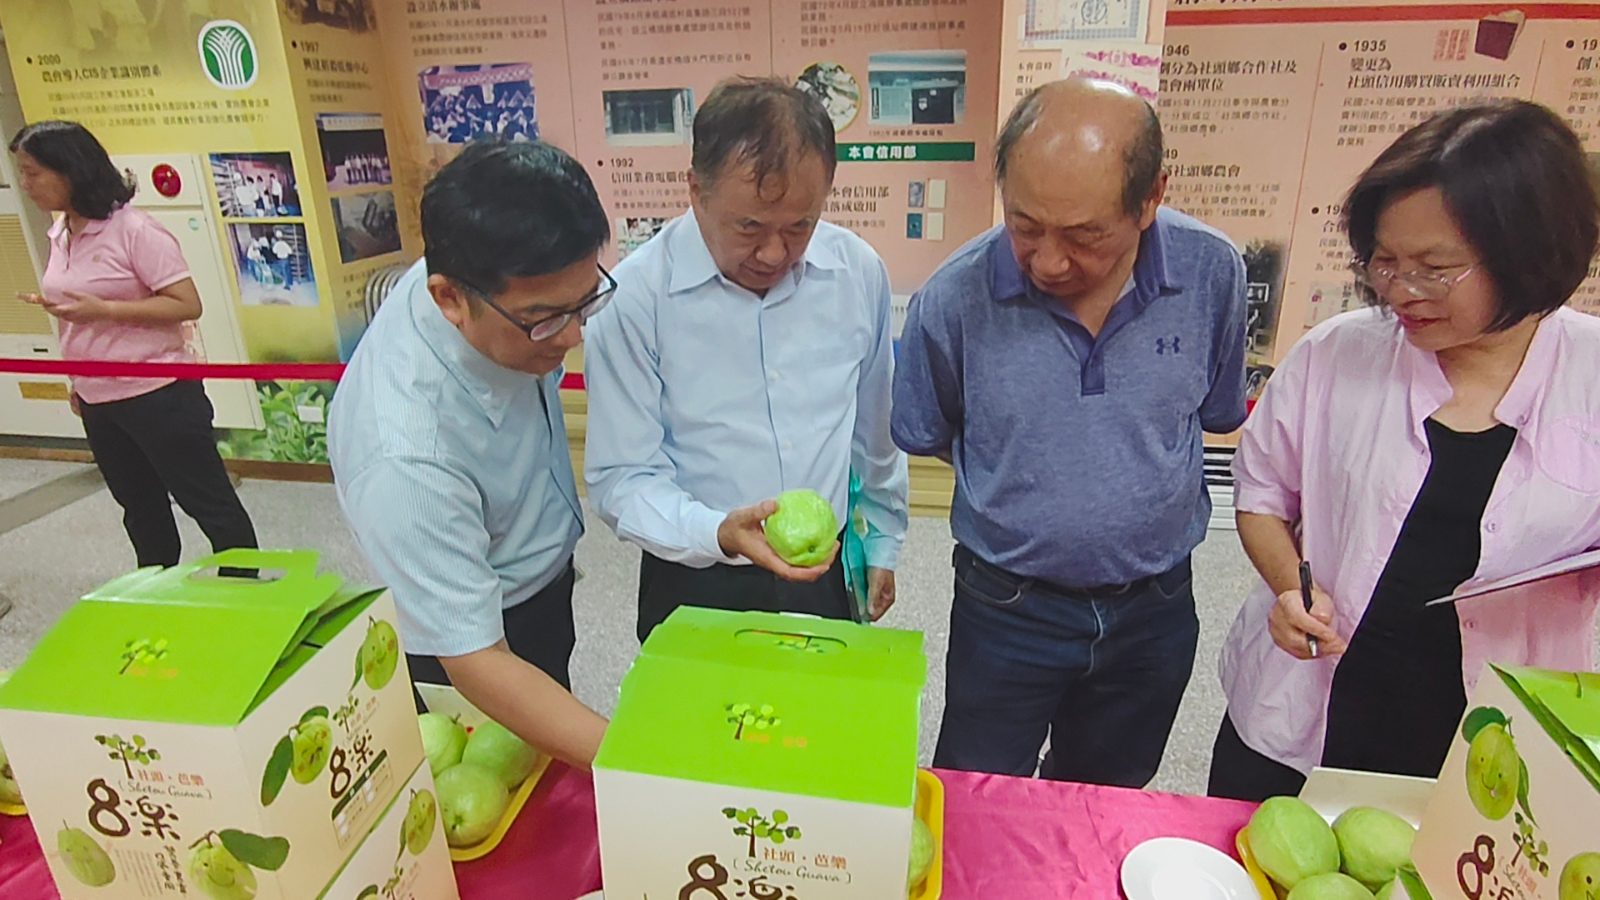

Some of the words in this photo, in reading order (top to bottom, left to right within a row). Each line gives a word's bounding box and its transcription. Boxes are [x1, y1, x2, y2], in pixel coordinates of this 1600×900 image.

[1161, 44, 1190, 56] 1946
[1354, 40, 1387, 52] 1935
[37, 53, 61, 66] 2000
[848, 145, 917, 159] 本會信用部
[611, 158, 634, 168] 1992
